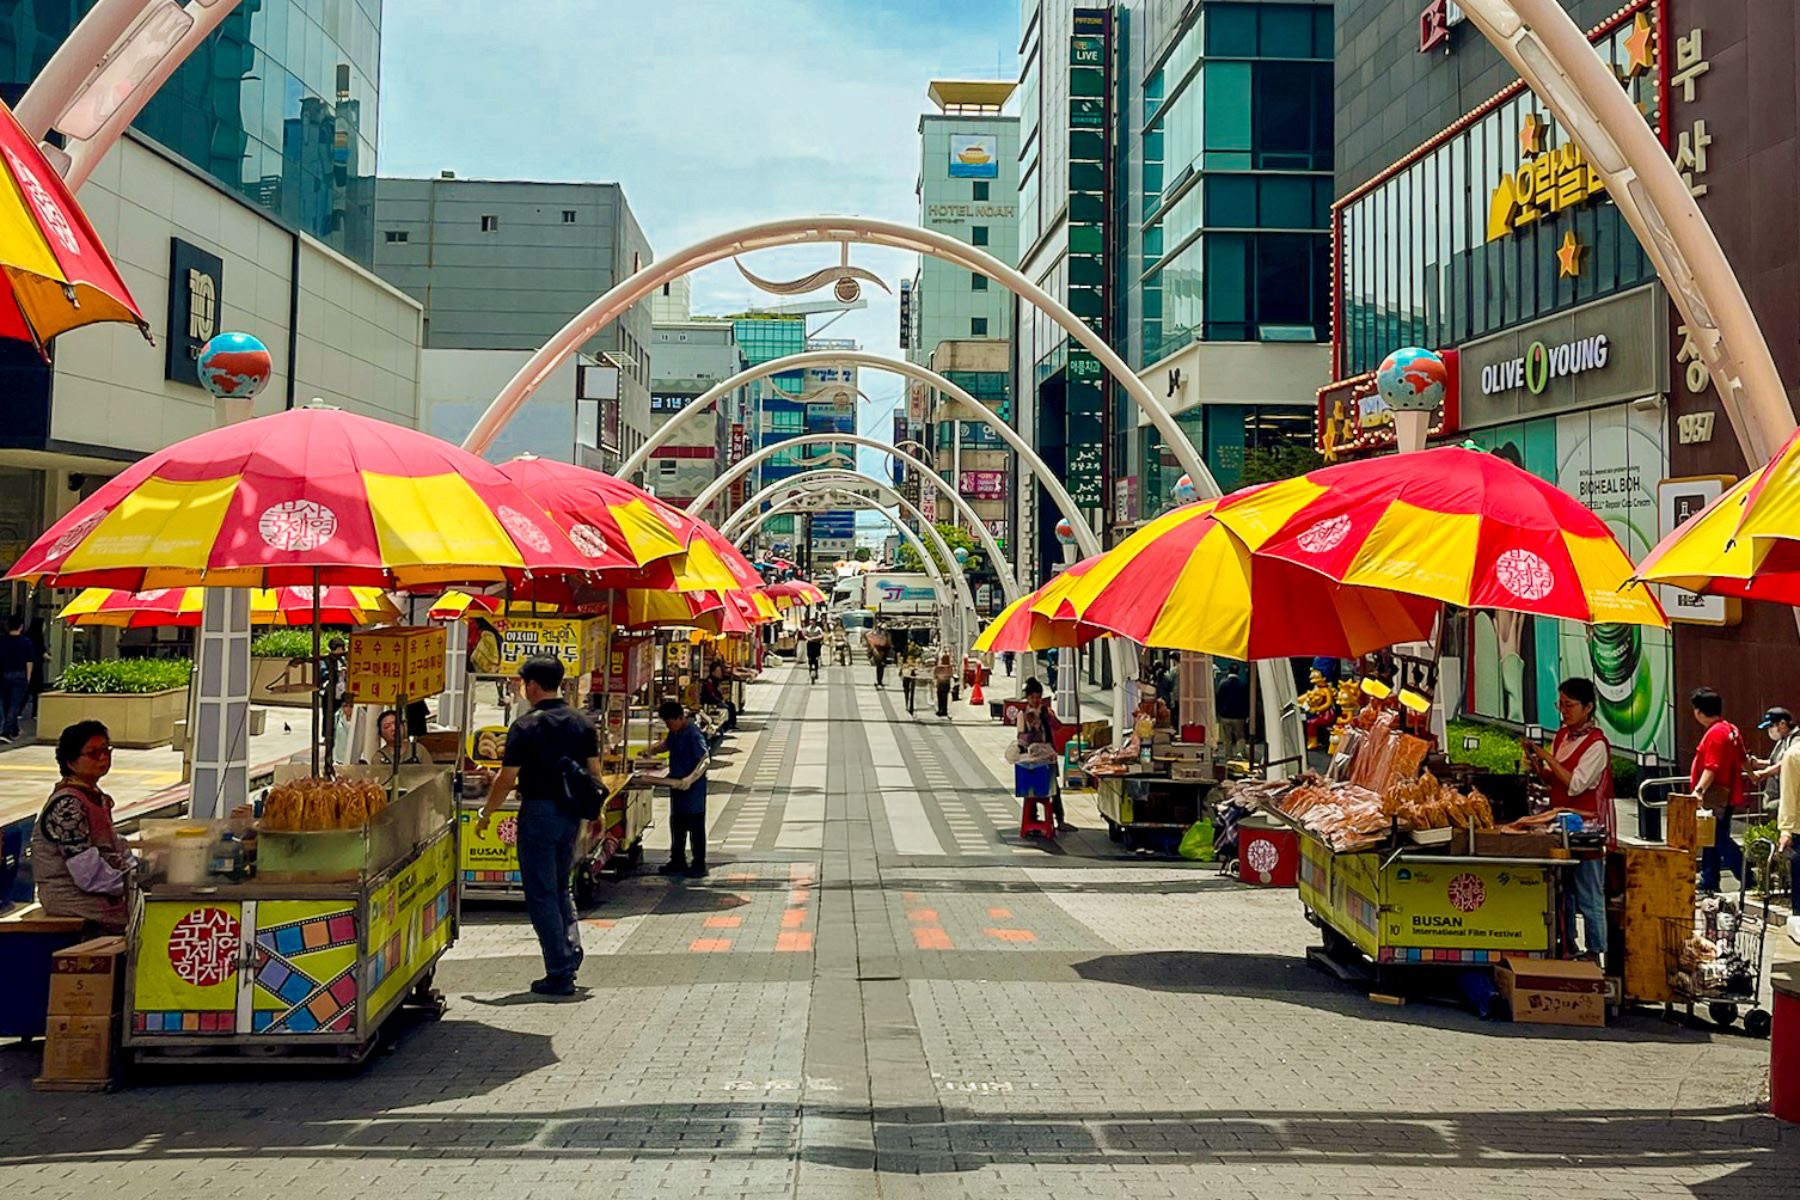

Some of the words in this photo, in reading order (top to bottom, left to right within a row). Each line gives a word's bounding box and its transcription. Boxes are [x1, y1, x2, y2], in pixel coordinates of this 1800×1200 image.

[1076, 51, 1098, 60] LIVE
[928, 205, 974, 217] HOTEL
[1481, 357, 1524, 395] OLIVE
[1548, 334, 1608, 378] YOUNG
[1677, 411, 1715, 444] 1937
[354, 639, 401, 656] 옥수수
[470, 848, 507, 856] BUSAN
[1412, 916, 1462, 927] BUSAN
[1412, 928, 1466, 936] International
[1468, 929, 1487, 937] Film
[1489, 929, 1522, 938] Festival
